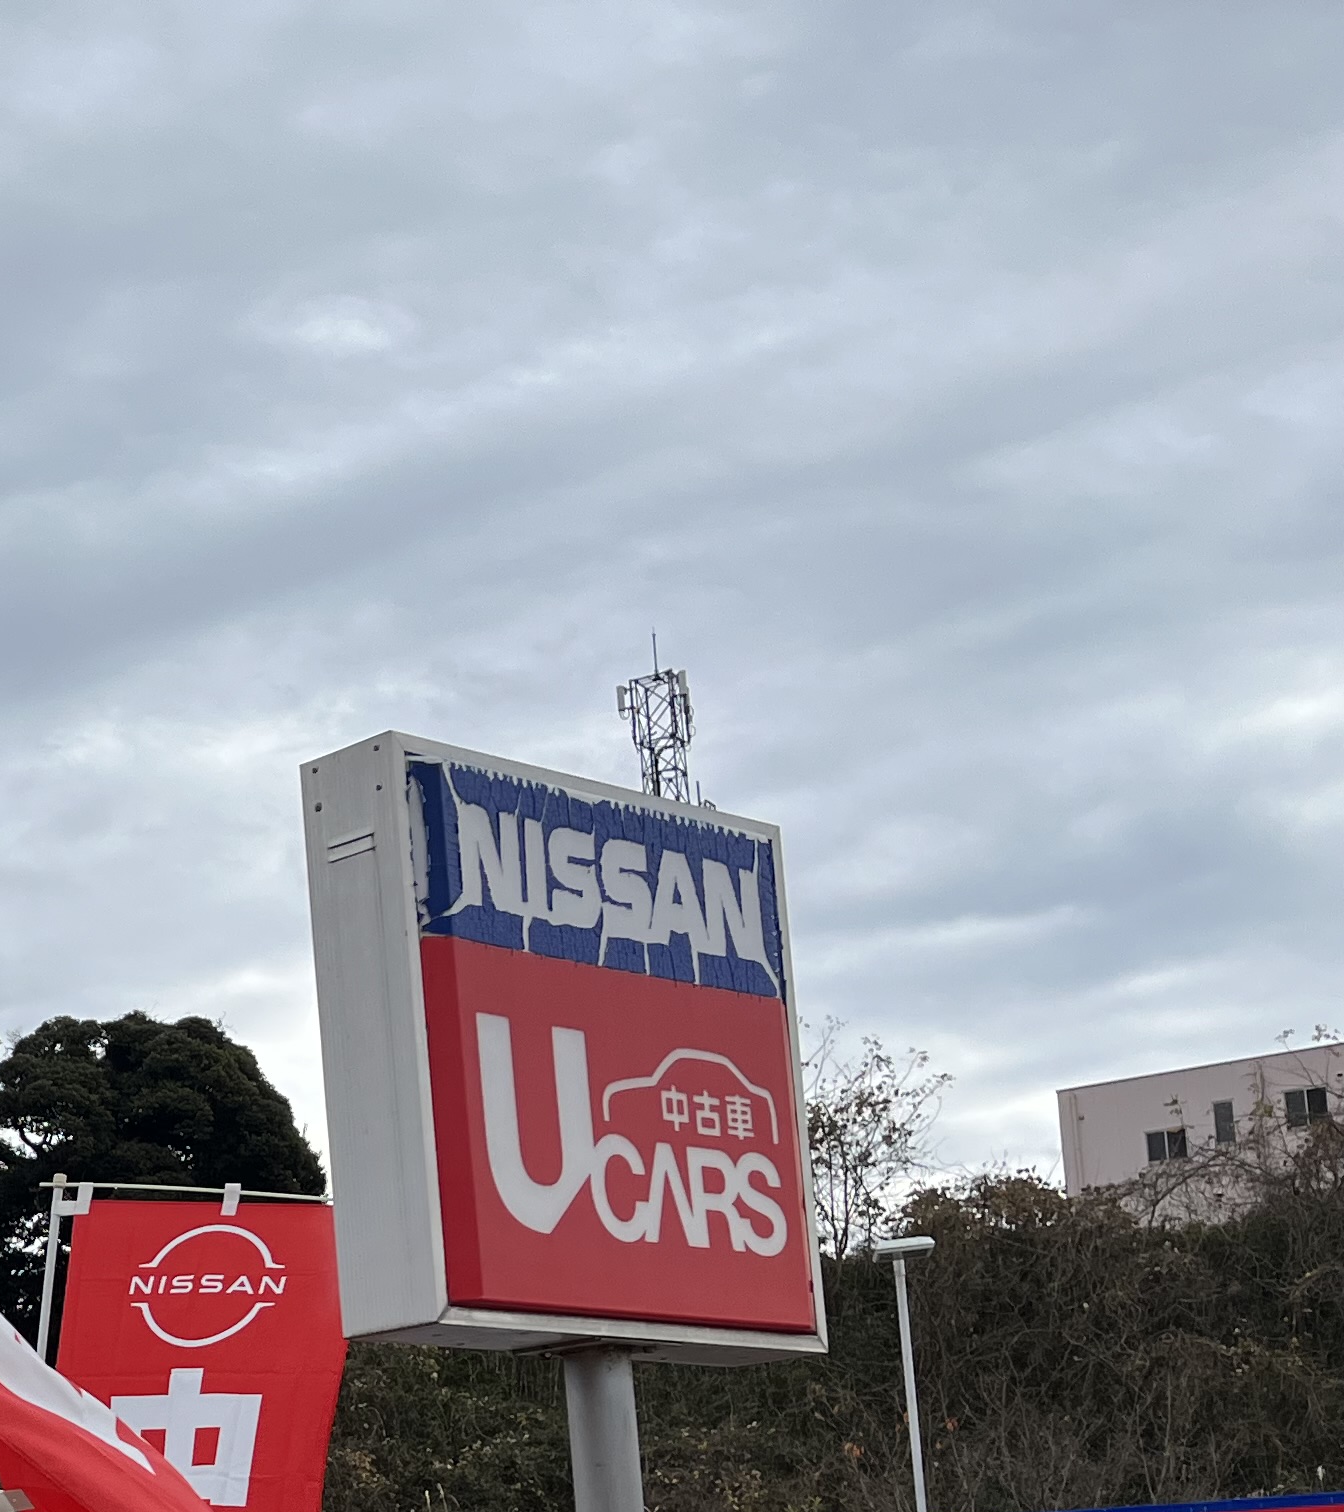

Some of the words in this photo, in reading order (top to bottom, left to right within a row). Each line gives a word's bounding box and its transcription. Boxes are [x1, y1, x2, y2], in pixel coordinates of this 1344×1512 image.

[458, 803, 764, 962] NISSAN
[660, 1084, 755, 1142] 中古車
[128, 1274, 288, 1296] NISSAN
